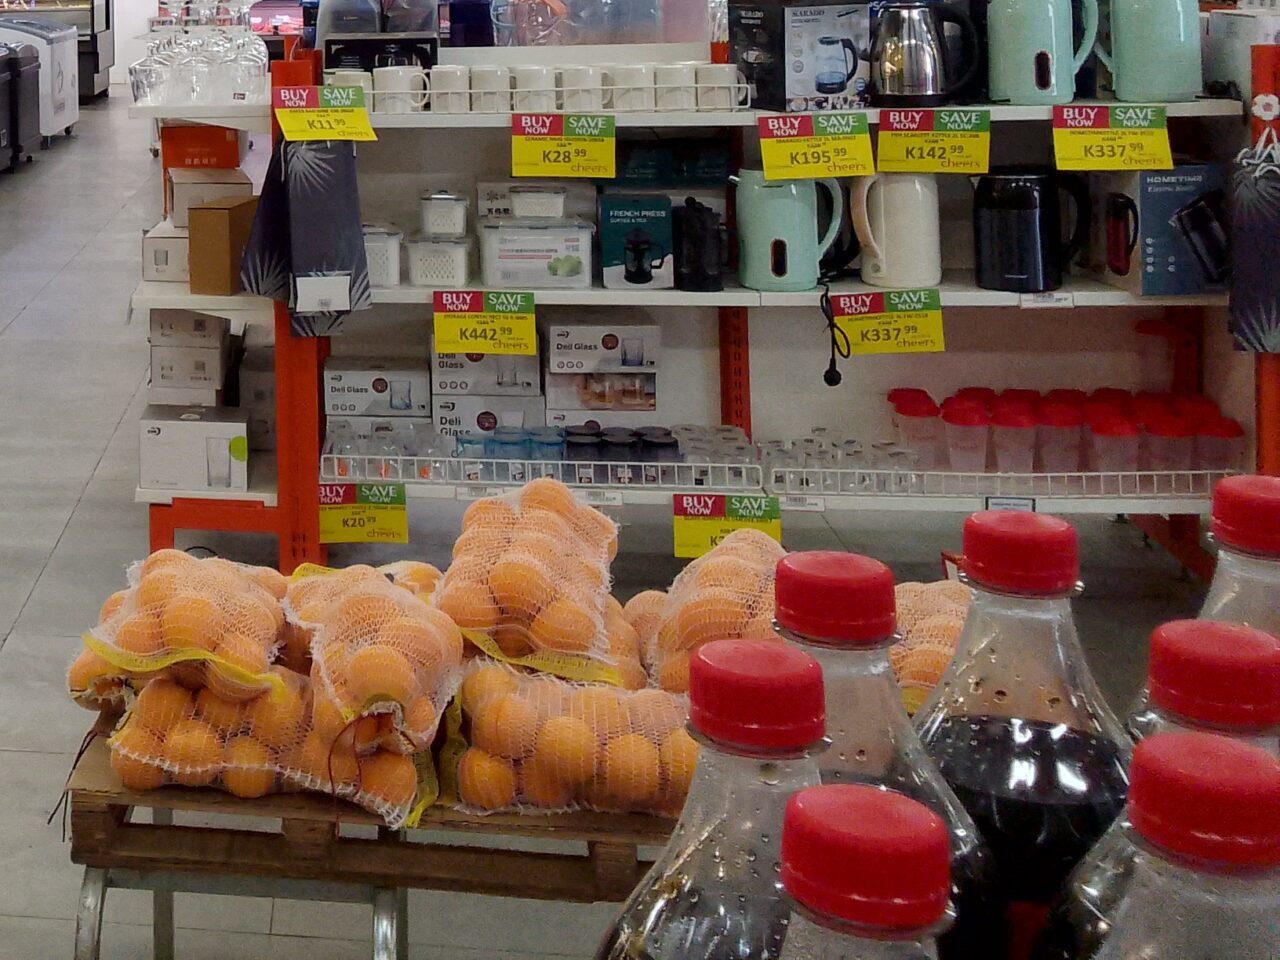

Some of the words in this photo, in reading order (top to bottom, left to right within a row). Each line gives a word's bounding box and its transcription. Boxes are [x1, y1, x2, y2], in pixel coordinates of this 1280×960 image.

[281, 89, 308, 100] BUY
[324, 89, 356, 99] SAVE
[890, 112, 923, 122] BUY
[940, 112, 980, 123] SAVE
[1063, 108, 1097, 119] BUY
[1116, 108, 1156, 119] SAVE
[307, 120, 334, 129] K11
[522, 116, 552, 127] BUY
[569, 117, 607, 128] SAVE
[768, 118, 801, 129] BUY
[819, 115, 858, 126] SAVE
[543, 151, 571, 163] K28
[574, 149, 586, 157] 99
[790, 151, 831, 164] K195
[834, 148, 846, 156] 99
[906, 147, 946, 159] K142
[951, 145, 963, 153] 99
[1084, 145, 1126, 157] K337
[571, 163, 607, 173] cheers
[827, 161, 866, 172] cheers
[443, 293, 472, 303] BUY
[489, 294, 525, 304] SAVE
[840, 295, 872, 307] BUY
[890, 291, 930, 303] SAVE
[460, 328, 497, 340] K442
[861, 328, 901, 341] K337
[440, 417, 461, 425] Deli
[362, 486, 397, 496] SAVE
[683, 496, 715, 507] BUY
[732, 497, 769, 510] SAVE
